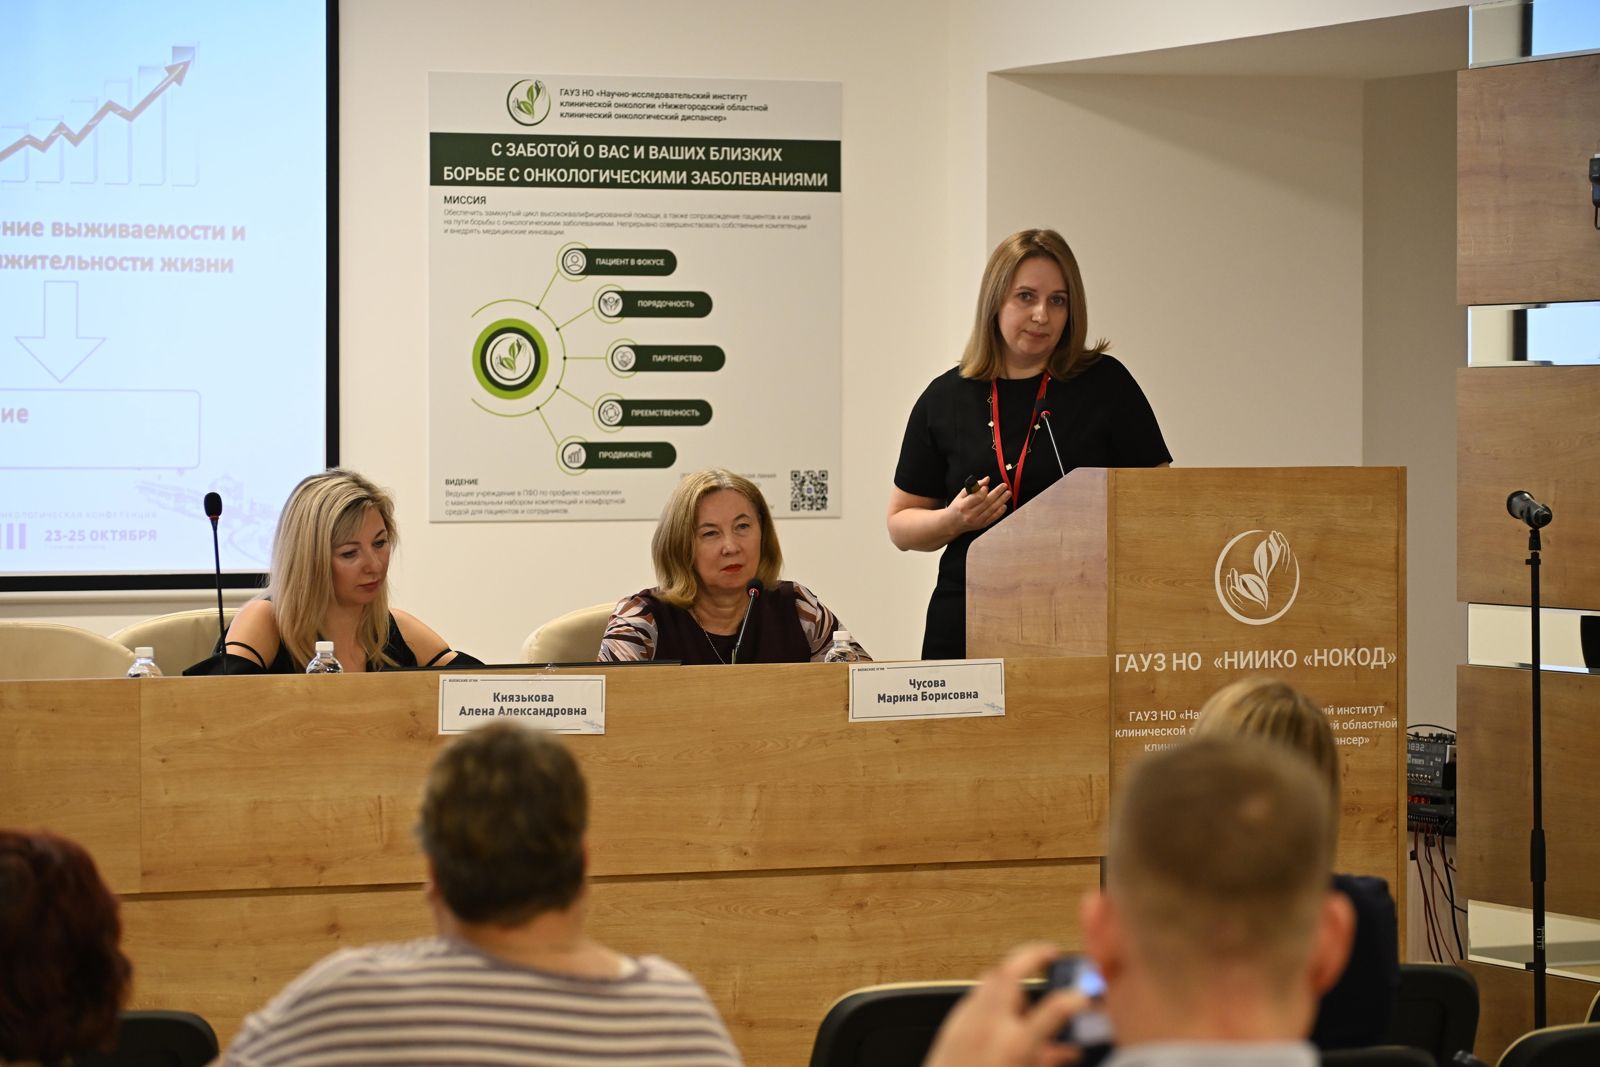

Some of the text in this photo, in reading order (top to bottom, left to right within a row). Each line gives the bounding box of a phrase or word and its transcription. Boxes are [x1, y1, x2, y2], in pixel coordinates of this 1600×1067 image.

[559, 88, 748, 102] ГАУЗ НО «Научно-исследовательский институт
[559, 100, 769, 113] клинической онкологии «Нижегородский областной
[559, 110, 727, 123] клинический онкологический диспансер»
[491, 140, 783, 162] С ЗАБОТОЙ О ВАС И ВАШИХ БЛИЗКИХ
[443, 166, 829, 188] БОРЬБЕ С ОНКОЛОГИЧЕСКИМИ ЗАБОЛЕВАНИЯМИ
[443, 195, 487, 205] МИССИЯ
[0, 221, 247, 242] ние выживаемости и
[0, 254, 234, 274] жительности жизни
[595, 257, 629, 268] ПАЦИЕНТ
[637, 257, 665, 267] ФОКУСЕ
[637, 299, 695, 309] ПОРЯДОЧНОСТЬ
[652, 354, 703, 363] ПАРТНЕРСТВО
[630, 408, 700, 418] ПРЕЕМСТВЕННОСТЬ
[598, 450, 653, 460] ПРОДВИЖЕНИЕ
[444, 478, 479, 486] ВИДЕНИЕ
[44, 529, 158, 542] 23-25 ОКТЯБРЯ
[1114, 647, 1397, 673] ГАУЗ НО «НИИКО «НОКОД»
[908, 678, 946, 691] Чусова
[493, 692, 554, 703] Князькова
[877, 690, 979, 705] Марина Борисовна
[459, 706, 587, 718] Алена Александровна
[1129, 710, 1158, 722] ГАУЗ
[1160, 709, 1177, 721] НО
[1337, 705, 1384, 716] институт
[1342, 718, 1398, 730] областной
[1115, 725, 1186, 738] клинической
